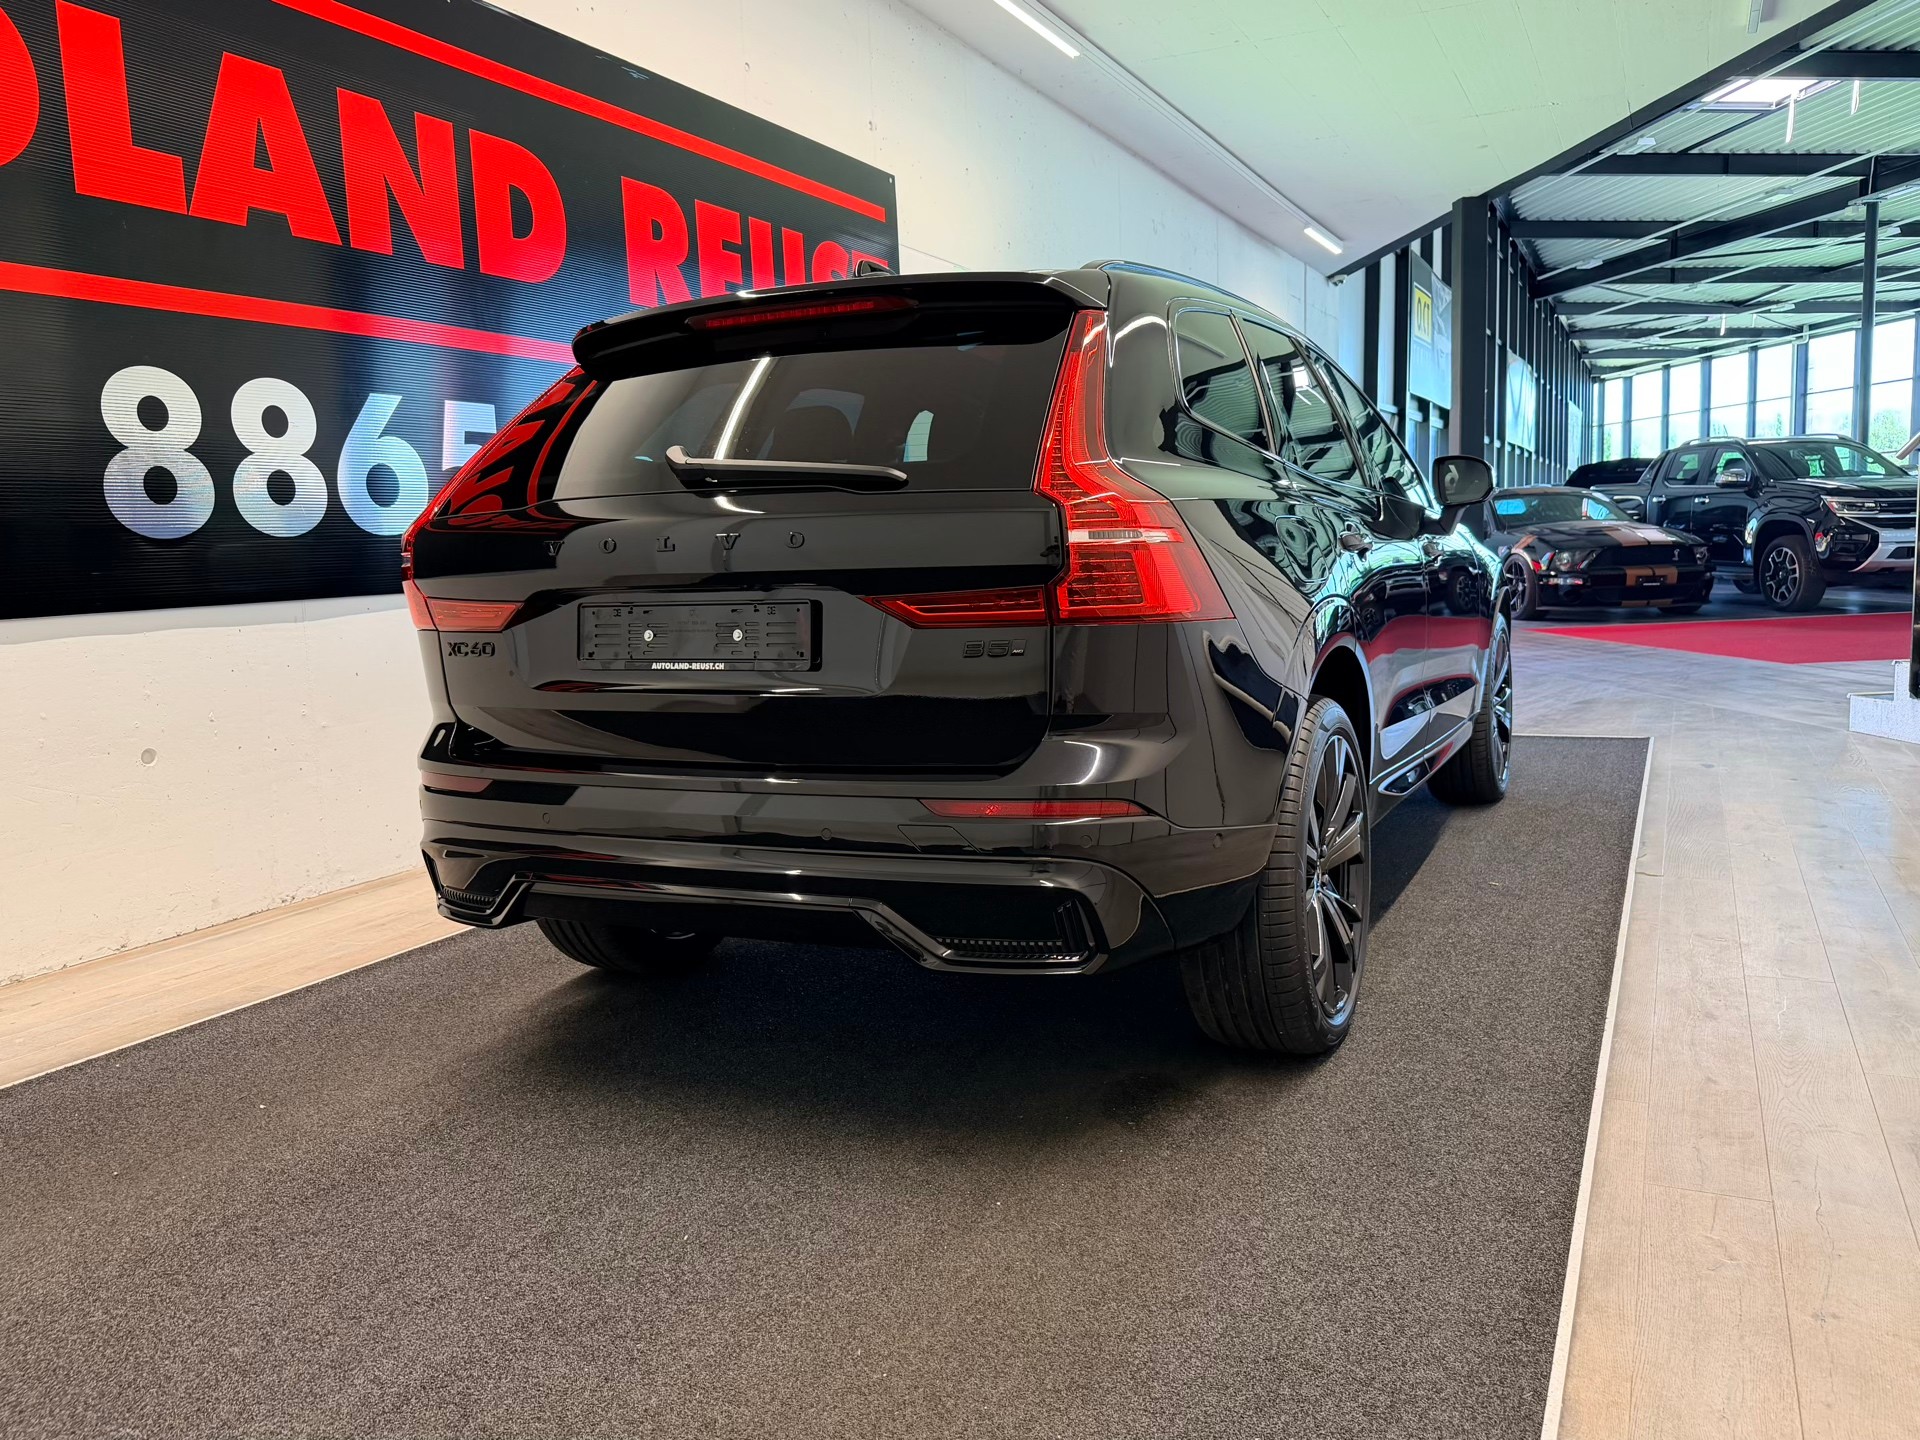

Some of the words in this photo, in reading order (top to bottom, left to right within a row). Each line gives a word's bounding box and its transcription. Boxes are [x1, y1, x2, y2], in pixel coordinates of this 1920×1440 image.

[0, 0, 567, 283] LAND
[622, 177, 889, 308] REU
[544, 531, 805, 557] VOLVO
[447, 642, 496, 657] XC60
[963, 640, 1010, 658] B5
[651, 661, 725, 670] AUTOLAND-REUST.CH
